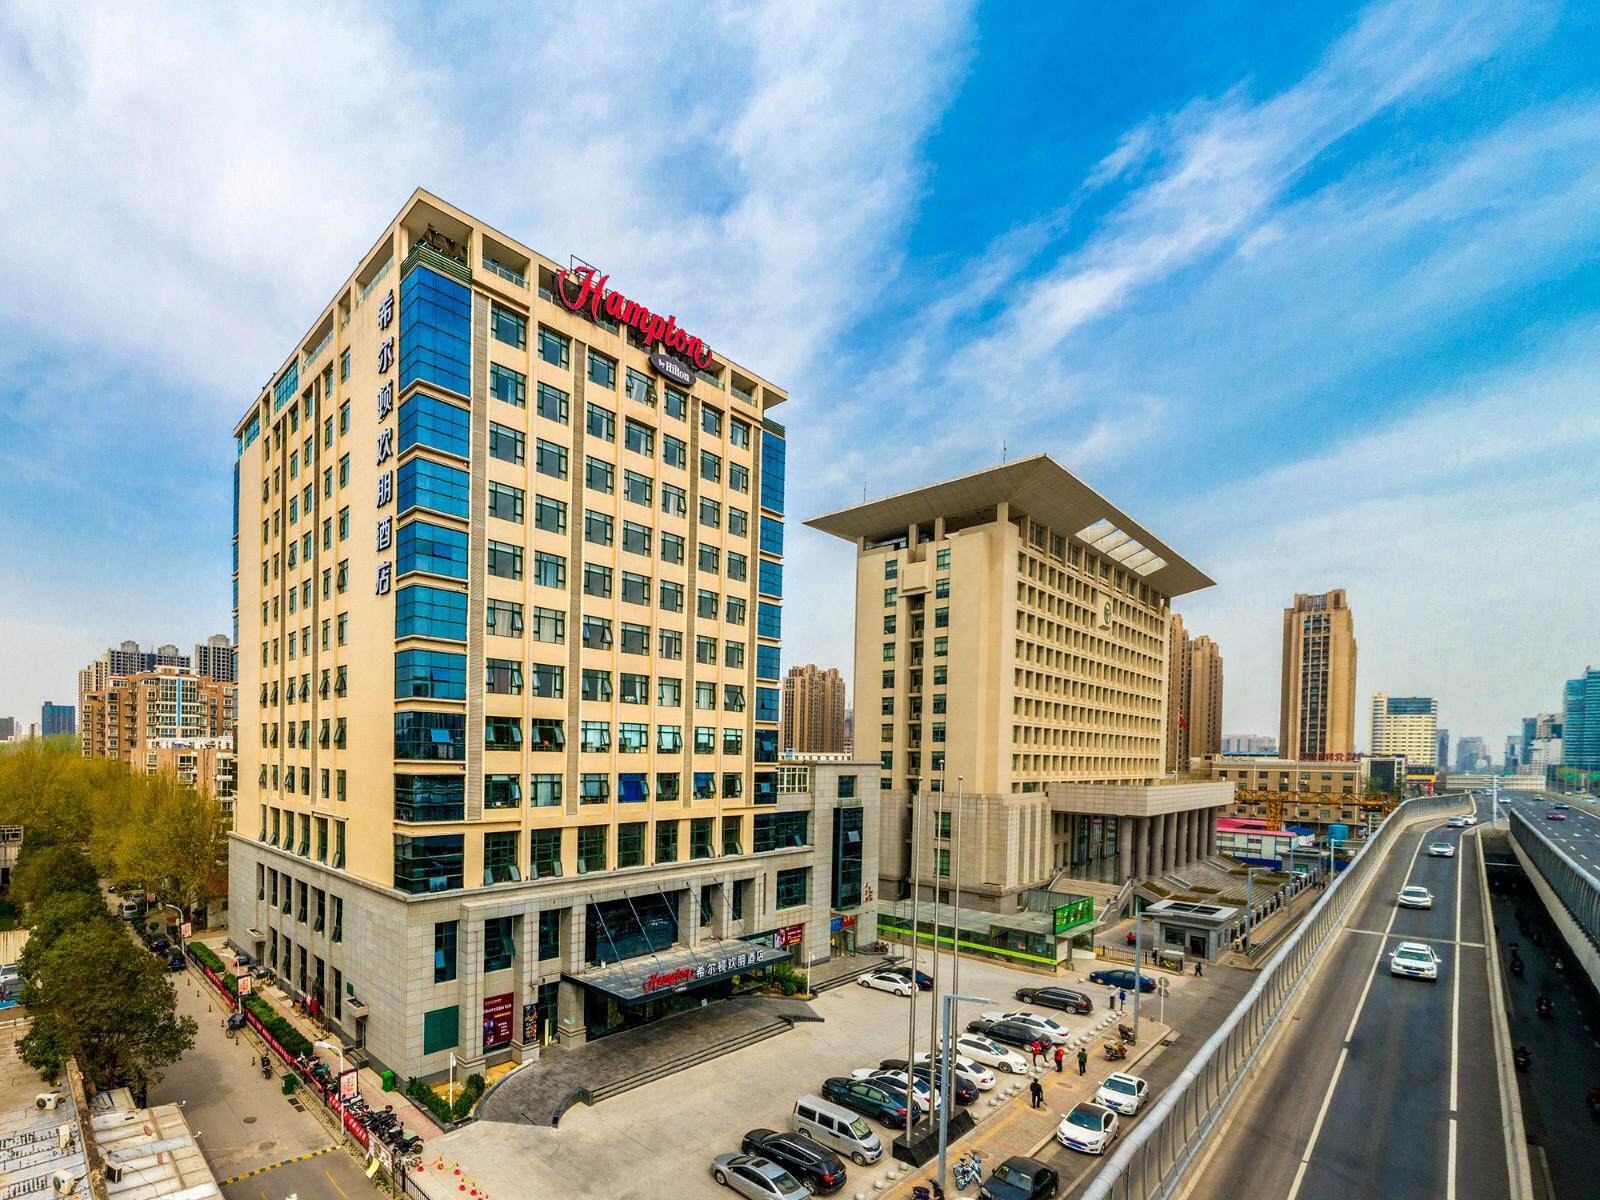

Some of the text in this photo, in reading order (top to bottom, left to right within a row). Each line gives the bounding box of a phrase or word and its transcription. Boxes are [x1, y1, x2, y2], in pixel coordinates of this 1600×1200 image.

[558, 266, 713, 369] Hampton
[658, 359, 690, 382] by Hilton
[375, 288, 395, 596] 希尔顿欢朋酒店
[695, 950, 764, 979] 希尔顿欢朋酒店
